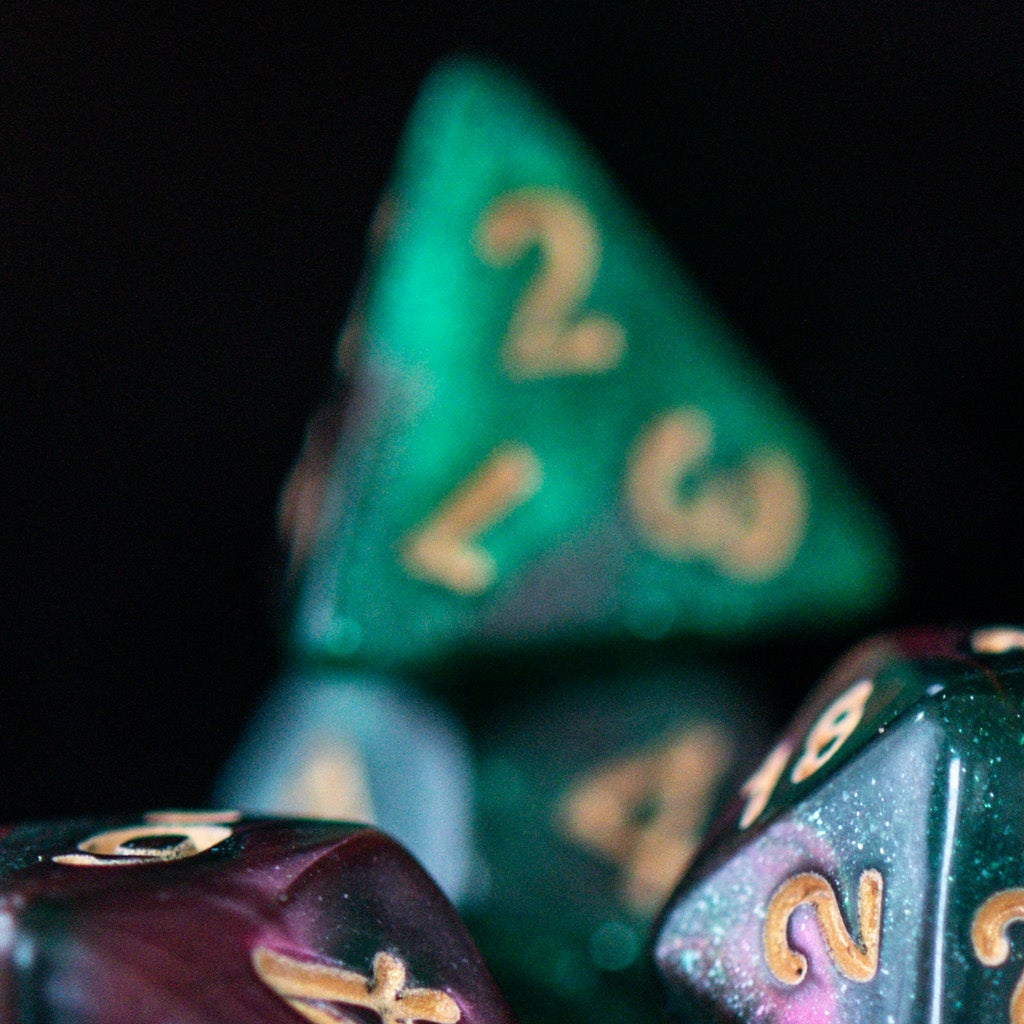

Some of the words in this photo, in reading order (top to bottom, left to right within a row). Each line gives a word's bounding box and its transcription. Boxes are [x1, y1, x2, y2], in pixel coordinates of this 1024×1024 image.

[474, 186, 628, 382] 2
[624, 404, 810, 586] 3
[764, 869, 884, 985] 2
